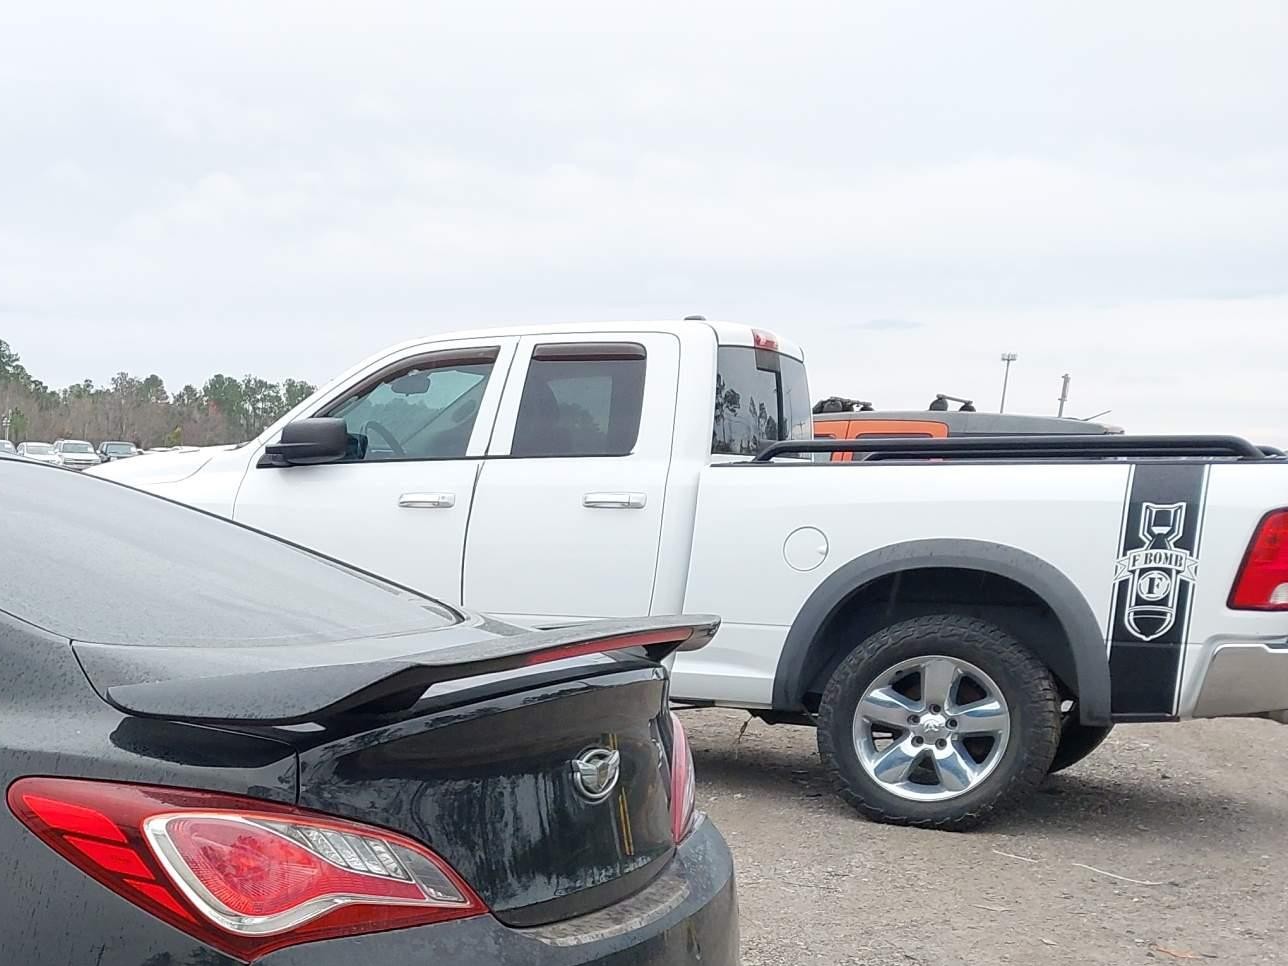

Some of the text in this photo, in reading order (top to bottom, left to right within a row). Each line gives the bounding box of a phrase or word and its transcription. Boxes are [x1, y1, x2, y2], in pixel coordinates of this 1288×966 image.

[1131, 551, 1184, 568] F BOMB
[1146, 577, 1163, 595] F
